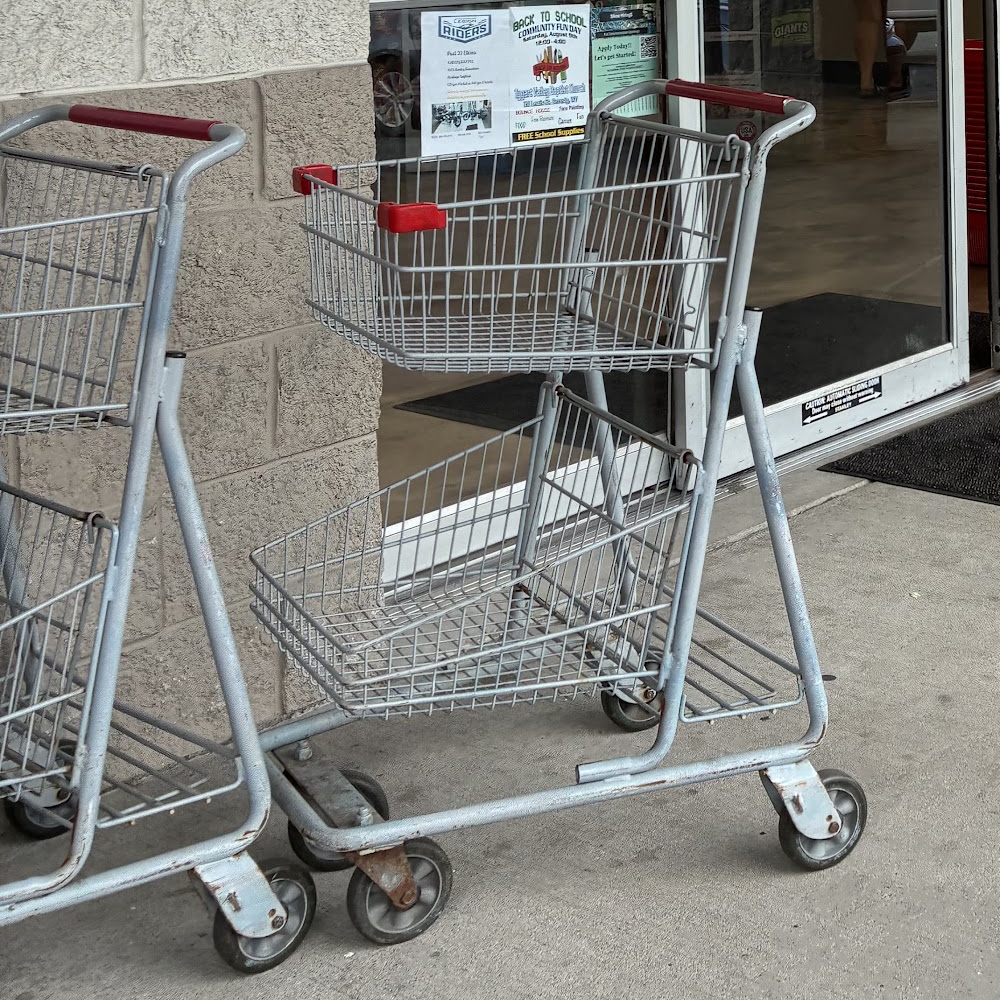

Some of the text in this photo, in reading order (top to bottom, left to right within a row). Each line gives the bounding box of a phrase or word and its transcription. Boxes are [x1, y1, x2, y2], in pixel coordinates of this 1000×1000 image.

[512, 11, 587, 32] BACK TO SCHOOL
[443, 24, 487, 39] RIDERS
[518, 23, 582, 39] COMMUNITY FUN DAY
[774, 22, 808, 38] GIANTS
[597, 45, 612, 53] Apply
[517, 127, 585, 141] FREE School Supplies
[826, 387, 852, 402] AUTOMATIC
[851, 381, 868, 393] SLIDING
[867, 376, 880, 387] DOOR
[811, 387, 874, 415] Door may close without warning
[834, 402, 852, 412] STANLEY
